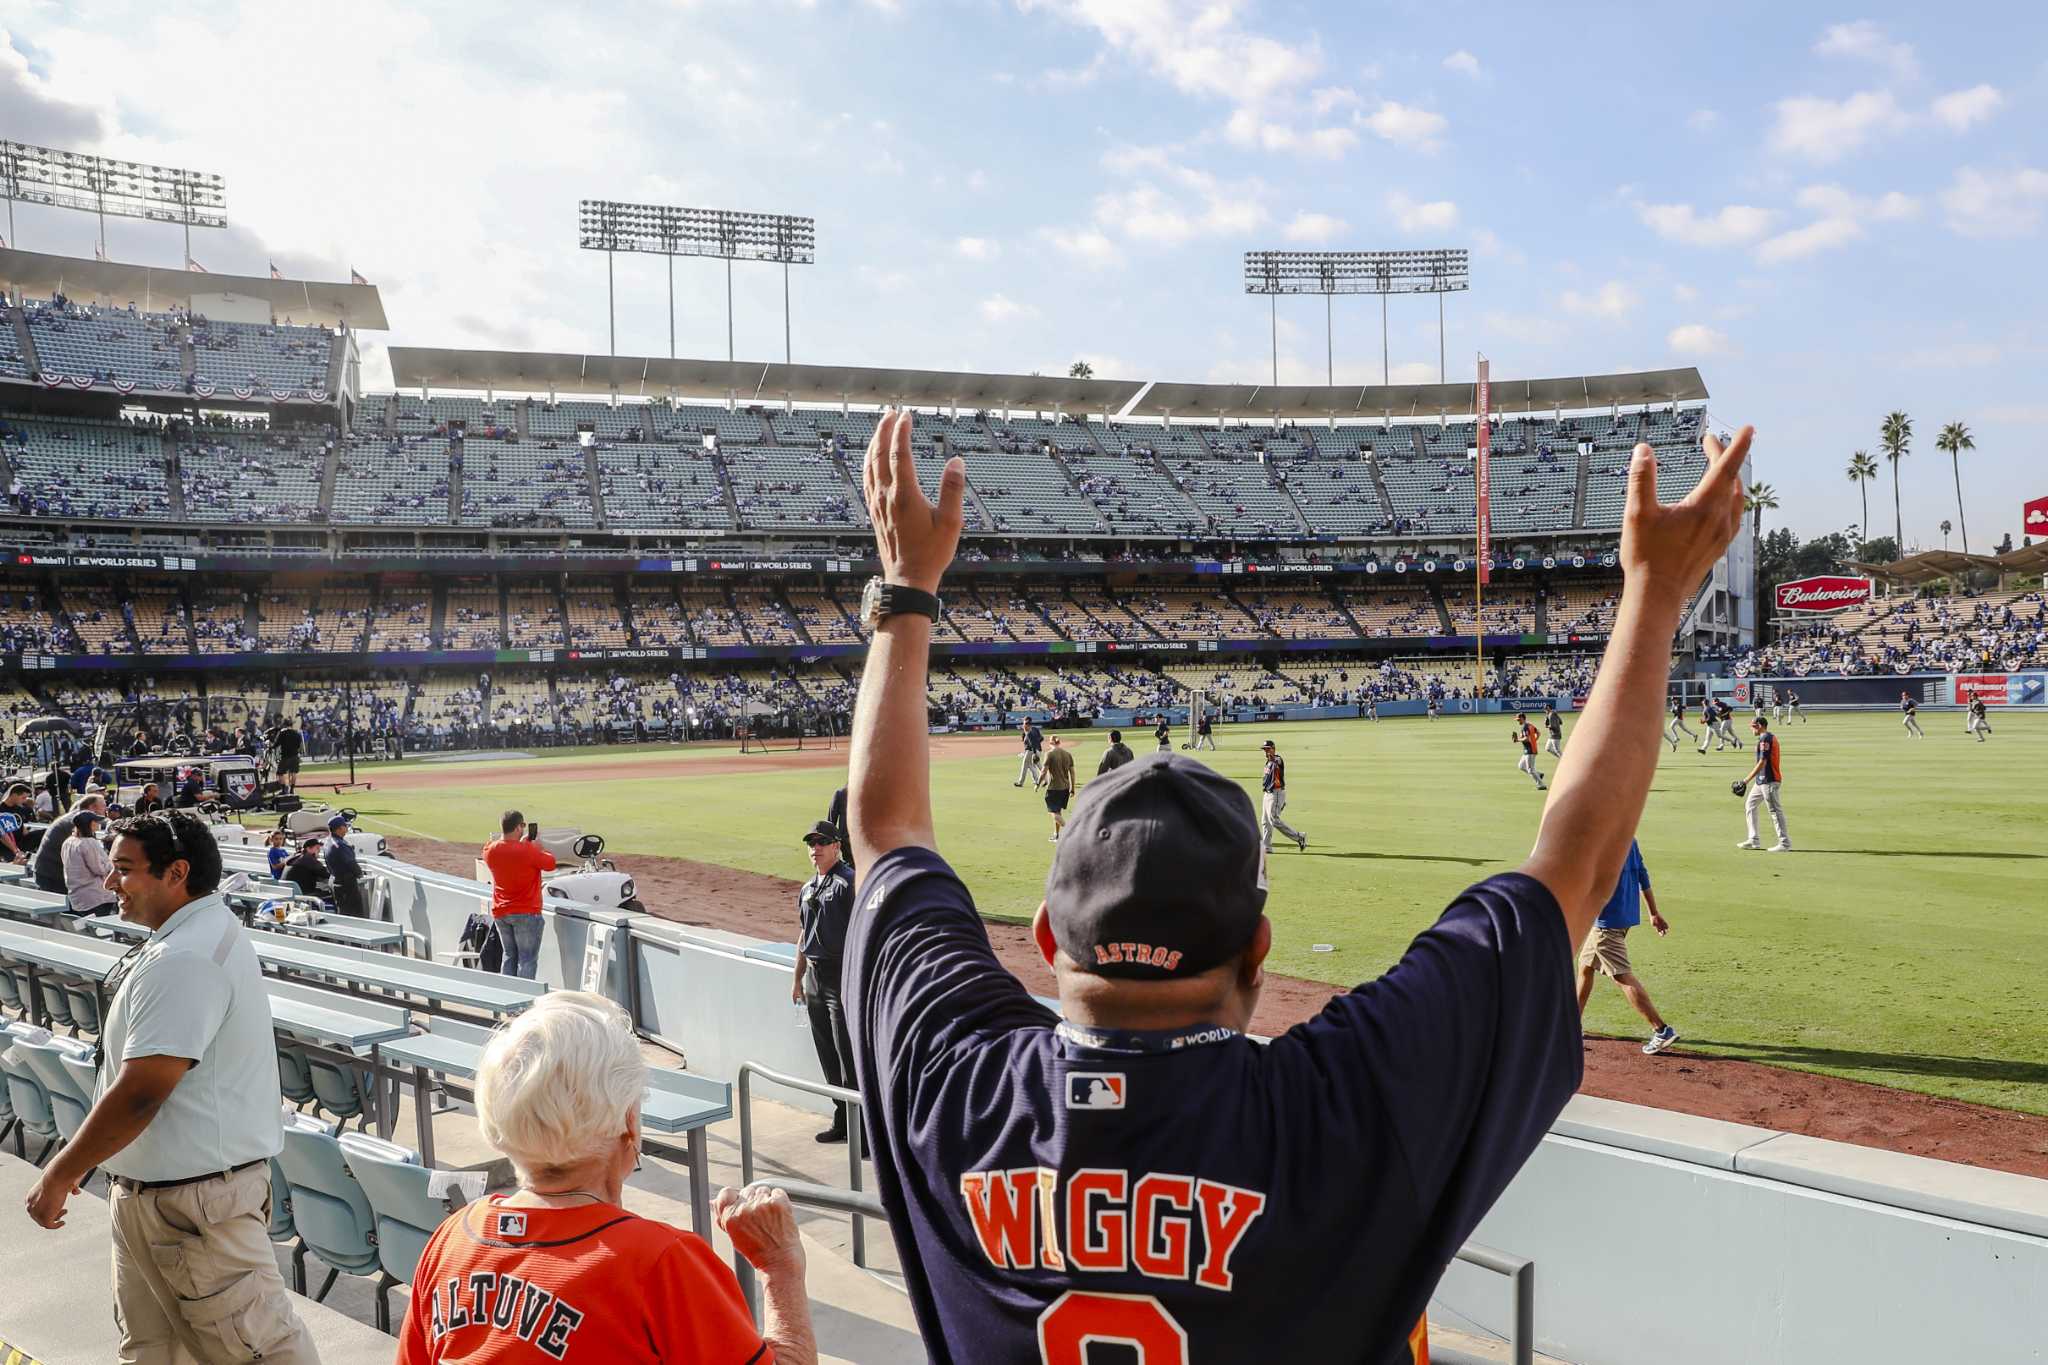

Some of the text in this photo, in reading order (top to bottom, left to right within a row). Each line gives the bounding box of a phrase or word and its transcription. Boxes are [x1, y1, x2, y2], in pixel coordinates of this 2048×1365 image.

[90, 557, 126, 567] WORLD
[126, 558, 157, 568] SERIES
[761, 560, 789, 569] WORLD
[789, 560, 812, 570] SERIES
[1290, 564, 1313, 572] WORLD
[1780, 585, 1868, 605] Budweiser
[619, 650, 646, 658] WORLD
[1736, 688, 1747, 697] 76
[1094, 943, 1183, 970] ASTROS
[1185, 1028, 1231, 1046] WORLD
[960, 1167, 1266, 1291] WIGGY
[432, 1271, 585, 1361] ALTUVE
